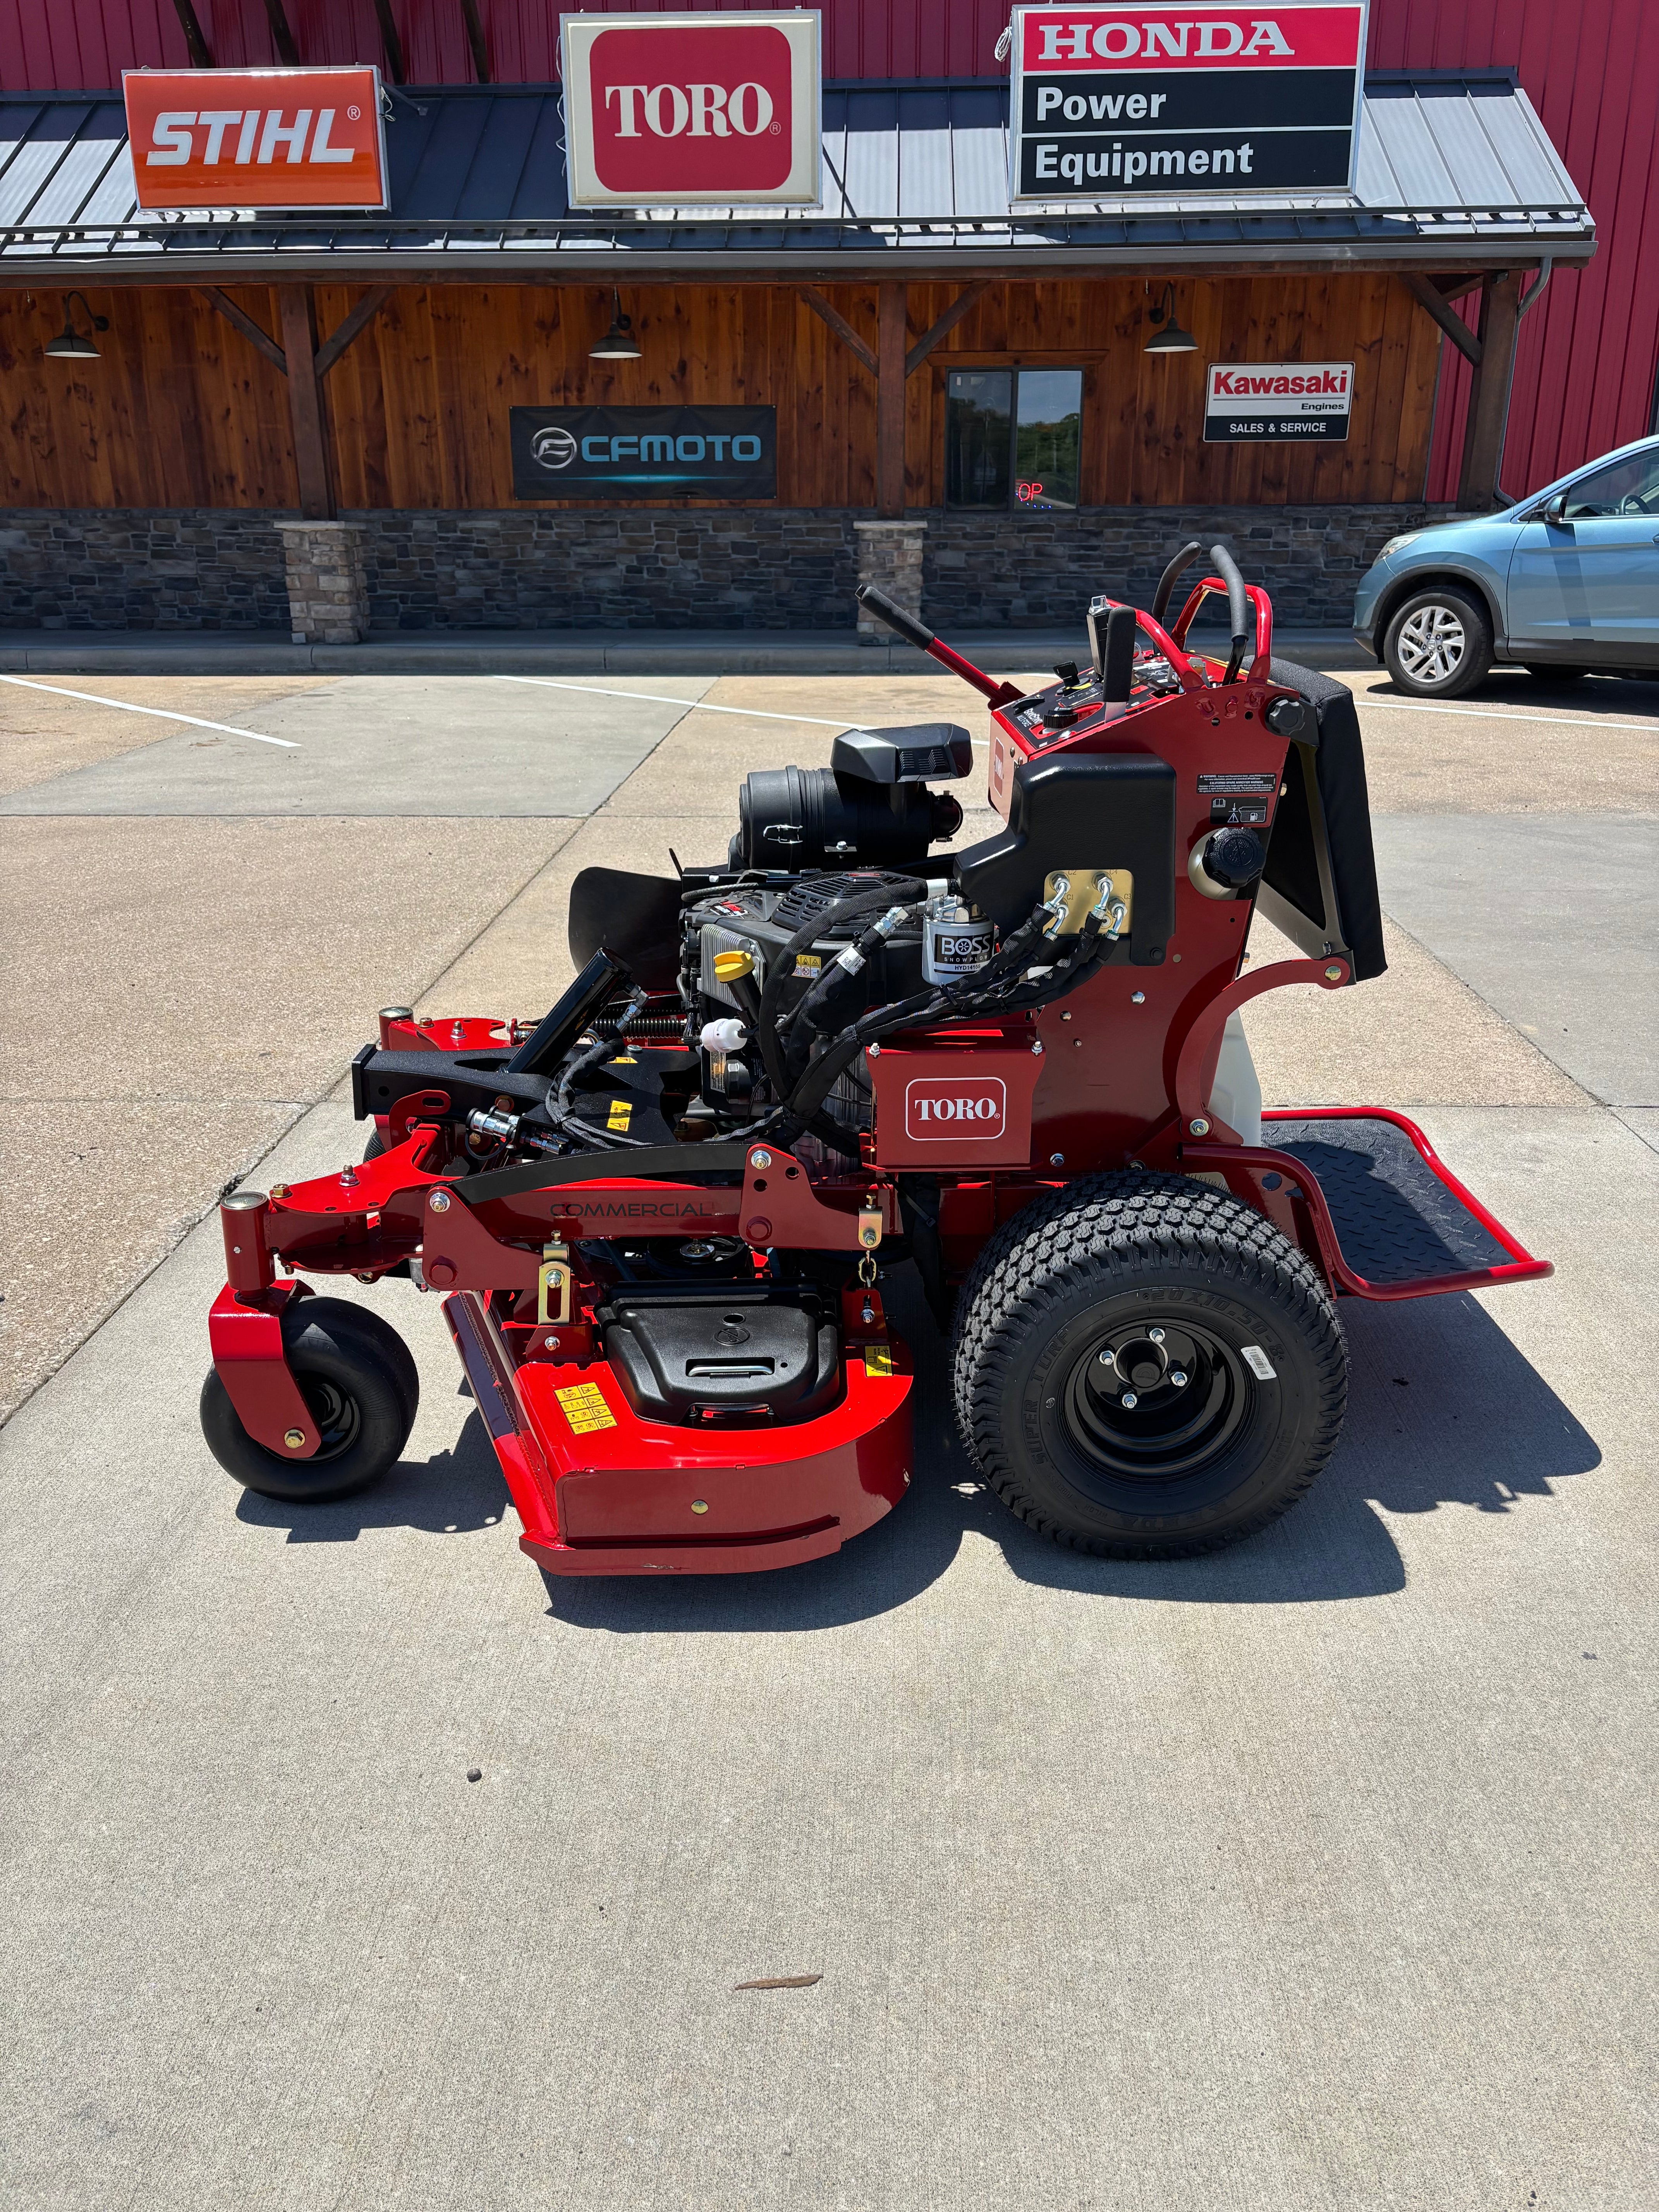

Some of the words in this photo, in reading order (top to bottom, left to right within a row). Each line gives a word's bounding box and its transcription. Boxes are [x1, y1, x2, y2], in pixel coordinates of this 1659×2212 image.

[1038, 21, 1295, 60] HONDA
[1036, 86, 1167, 121] Power
[1036, 142, 1254, 185] Equipment
[1214, 370, 1347, 395] Kawasaki
[1301, 403, 1344, 411] Engines
[1230, 423, 1264, 433] SALES
[1268, 423, 1276, 433] &
[1280, 422, 1327, 433] SERVICE
[581, 435, 761, 462] CFMOTO
[941, 935, 990, 955] BOSS
[915, 1098, 996, 1120] TORO
[550, 1203, 713, 1217] COMMERCIAL
[1030, 1329, 1068, 1382] TURF
[1023, 1400, 1048, 1464] SUPER
